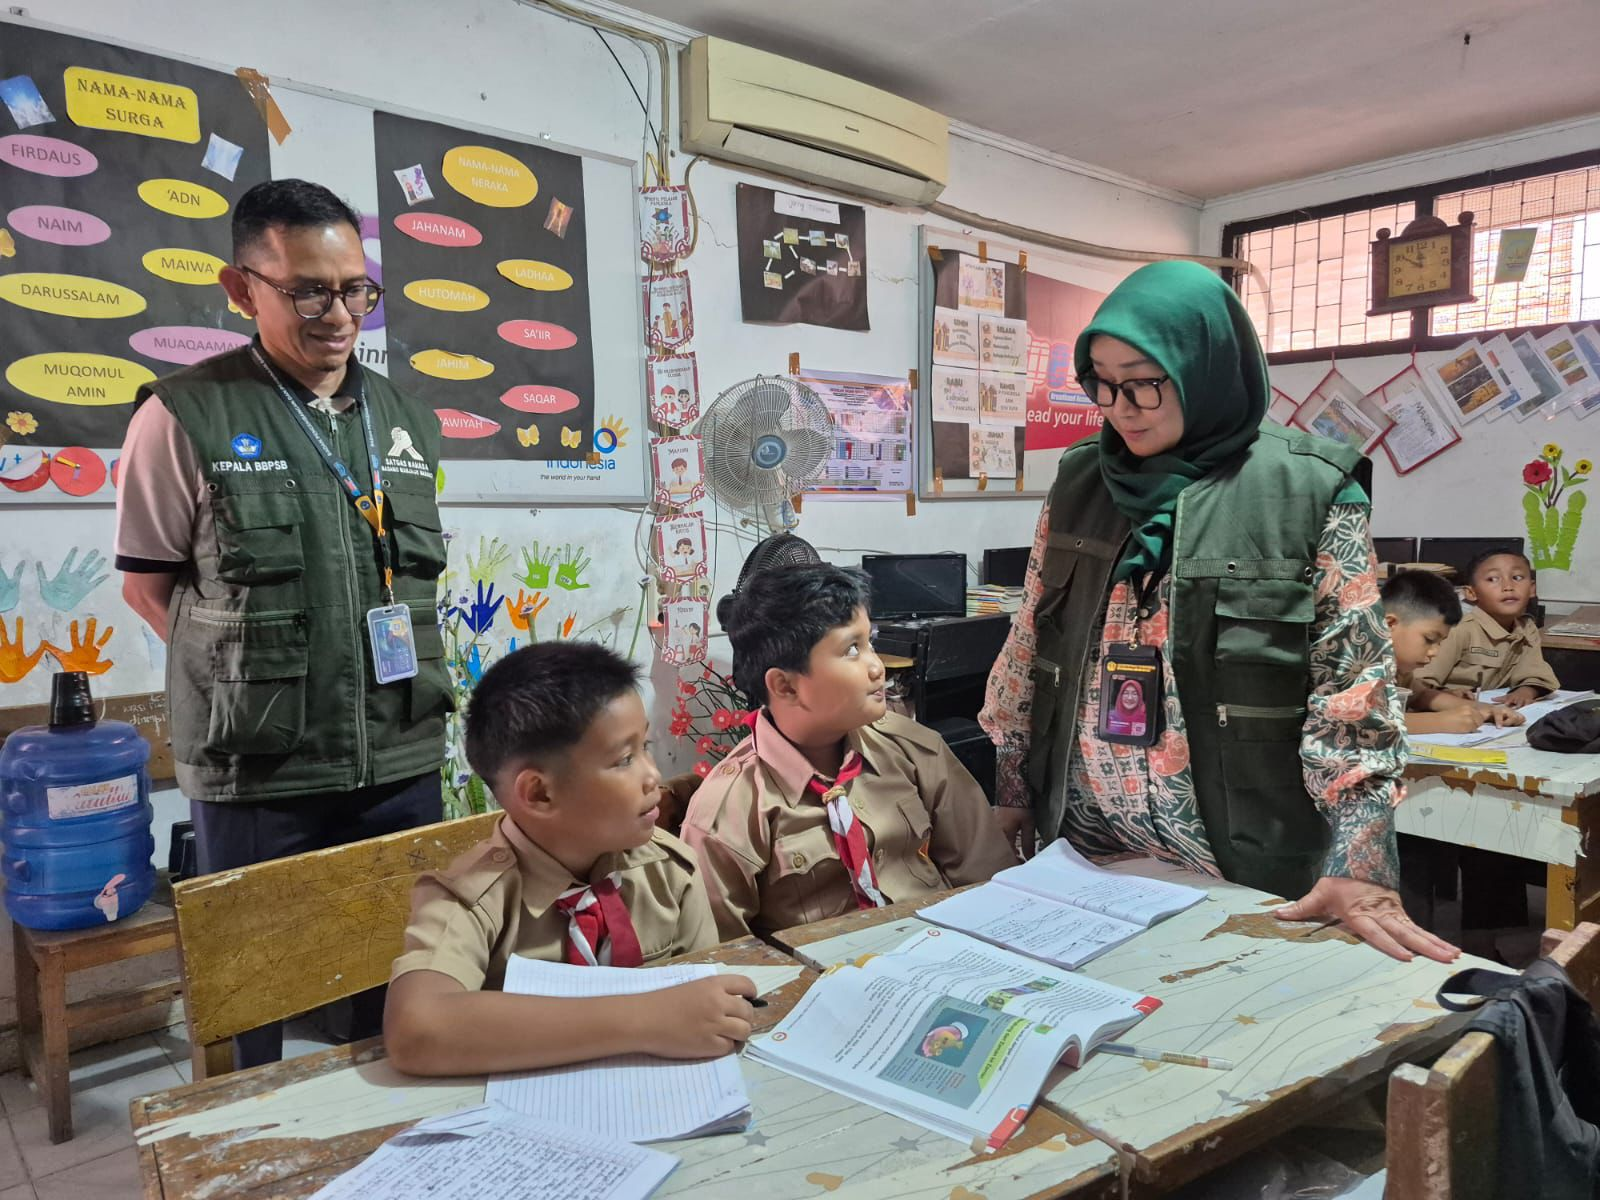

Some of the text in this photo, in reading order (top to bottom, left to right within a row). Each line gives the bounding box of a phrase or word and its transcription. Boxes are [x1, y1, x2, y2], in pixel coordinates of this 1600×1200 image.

[77, 78, 187, 111] NAMA-NAMA
[106, 107, 164, 129] SURGA
[11, 143, 82, 166] FIRDAUS
[458, 156, 520, 178] NAMA-NAMA
[471, 177, 509, 193] NERAKA
[37, 216, 83, 234] NAIM
[411, 220, 466, 239] JAHANAM
[161, 256, 215, 275] MAIWA
[515, 267, 555, 282] LADHAA
[21, 283, 120, 306] DARUSSALAM
[418, 287, 476, 304] HUTOMAH
[523, 328, 551, 340] SA'IIR
[44, 363, 124, 379] MUQOMUL
[66, 386, 106, 398] AMIN
[523, 392, 557, 405] SAQAR
[440, 417, 483, 429] AWIYAH
[1026, 407, 1105, 429] ead your life
[211, 460, 288, 472] KEPALA BBPSB
